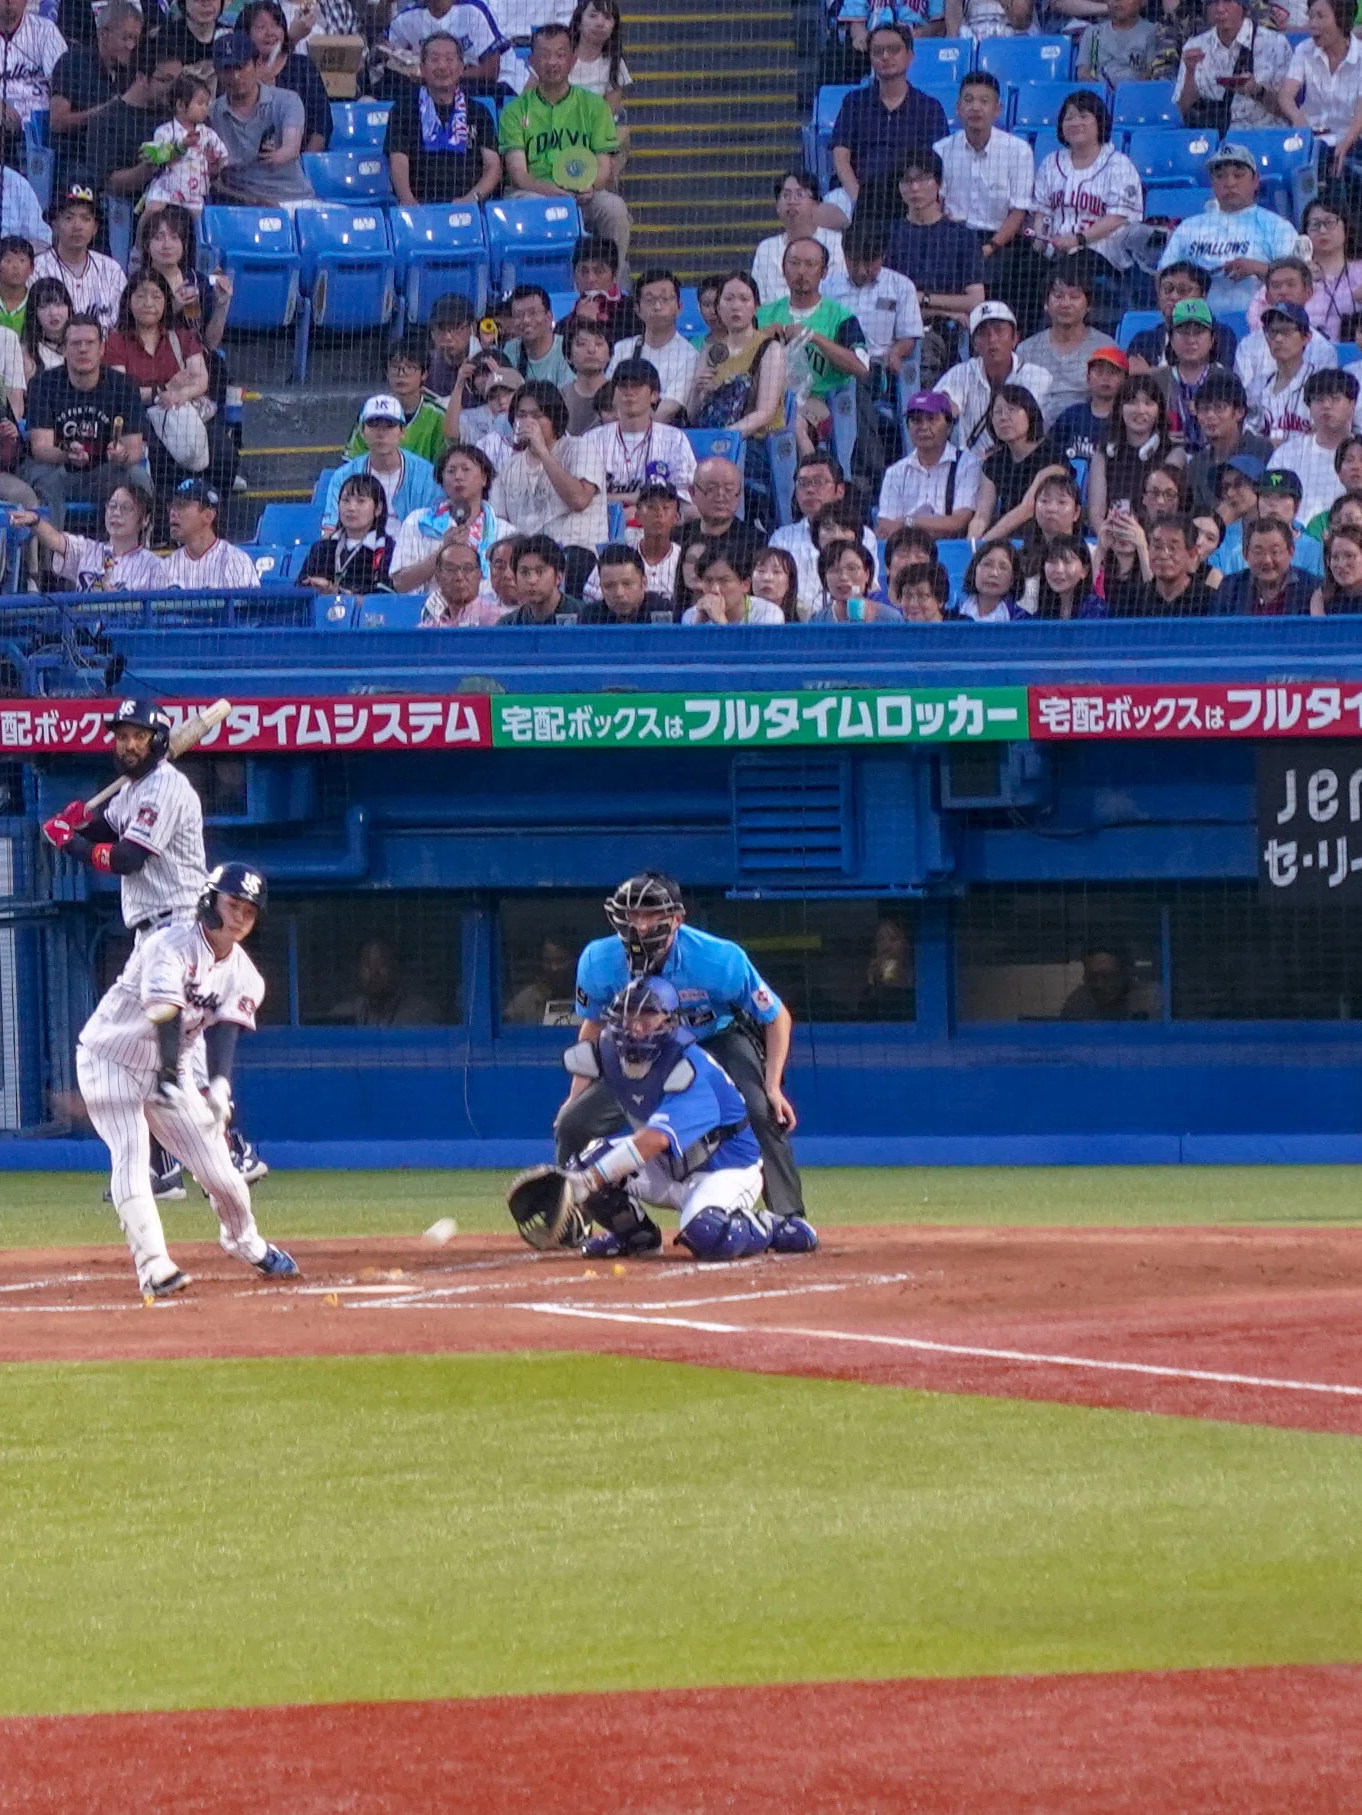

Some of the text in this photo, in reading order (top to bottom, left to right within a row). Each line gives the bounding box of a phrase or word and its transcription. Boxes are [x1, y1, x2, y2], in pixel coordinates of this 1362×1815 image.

[1189, 240, 1250, 256] SWALLOWS
[501, 694, 1018, 742] 宅配ボックスはフルタイムロッカー
